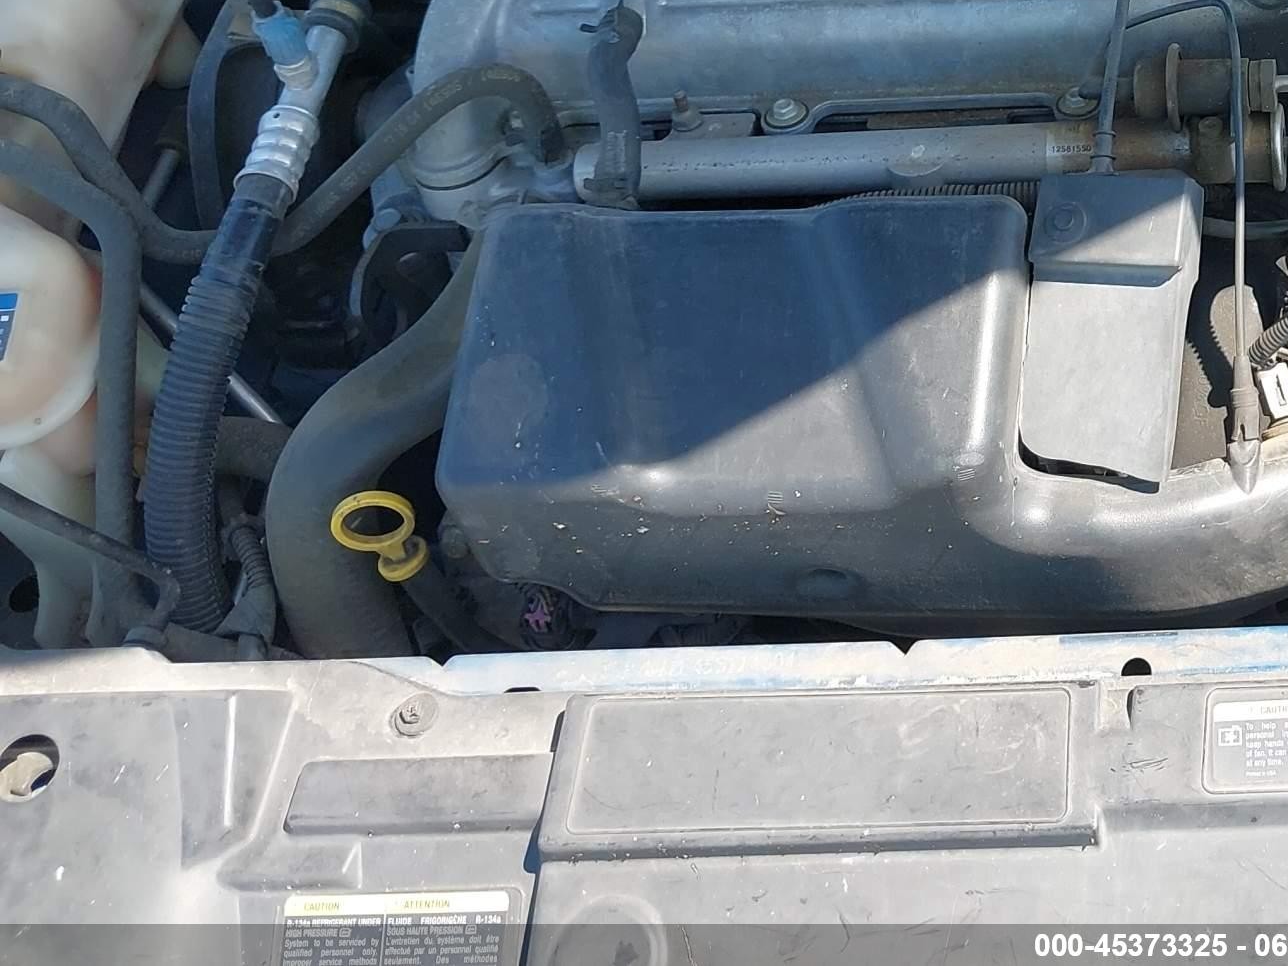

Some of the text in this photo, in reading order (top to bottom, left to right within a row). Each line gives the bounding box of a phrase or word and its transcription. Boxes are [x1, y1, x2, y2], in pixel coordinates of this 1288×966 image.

[1246, 722, 1254, 731] To
[1262, 721, 1277, 731] help
[304, 902, 340, 911] CAUTION
[404, 899, 450, 909] ATTENTION
[287, 917, 381, 928] R-134a REFRIGERANT UNDER
[388, 917, 412, 925] FLUIDE
[475, 915, 502, 924] R-134a
[286, 928, 339, 938] HIGH PRESSURE
[386, 925, 464, 936] SOUS HAUTE PRESSION
[284, 937, 379, 949] System to be serviced by
[386, 936, 420, 946] L'entretien
[424, 936, 433, 945] du
[469, 935, 481, 944] doit
[283, 948, 313, 958] qualified
[320, 948, 354, 957] personnel
[414, 947, 425, 956] par
[440, 946, 472, 955] personnel
[348, 957, 378, 966] methods
[384, 955, 498, 965] seulement. Des méthodes
